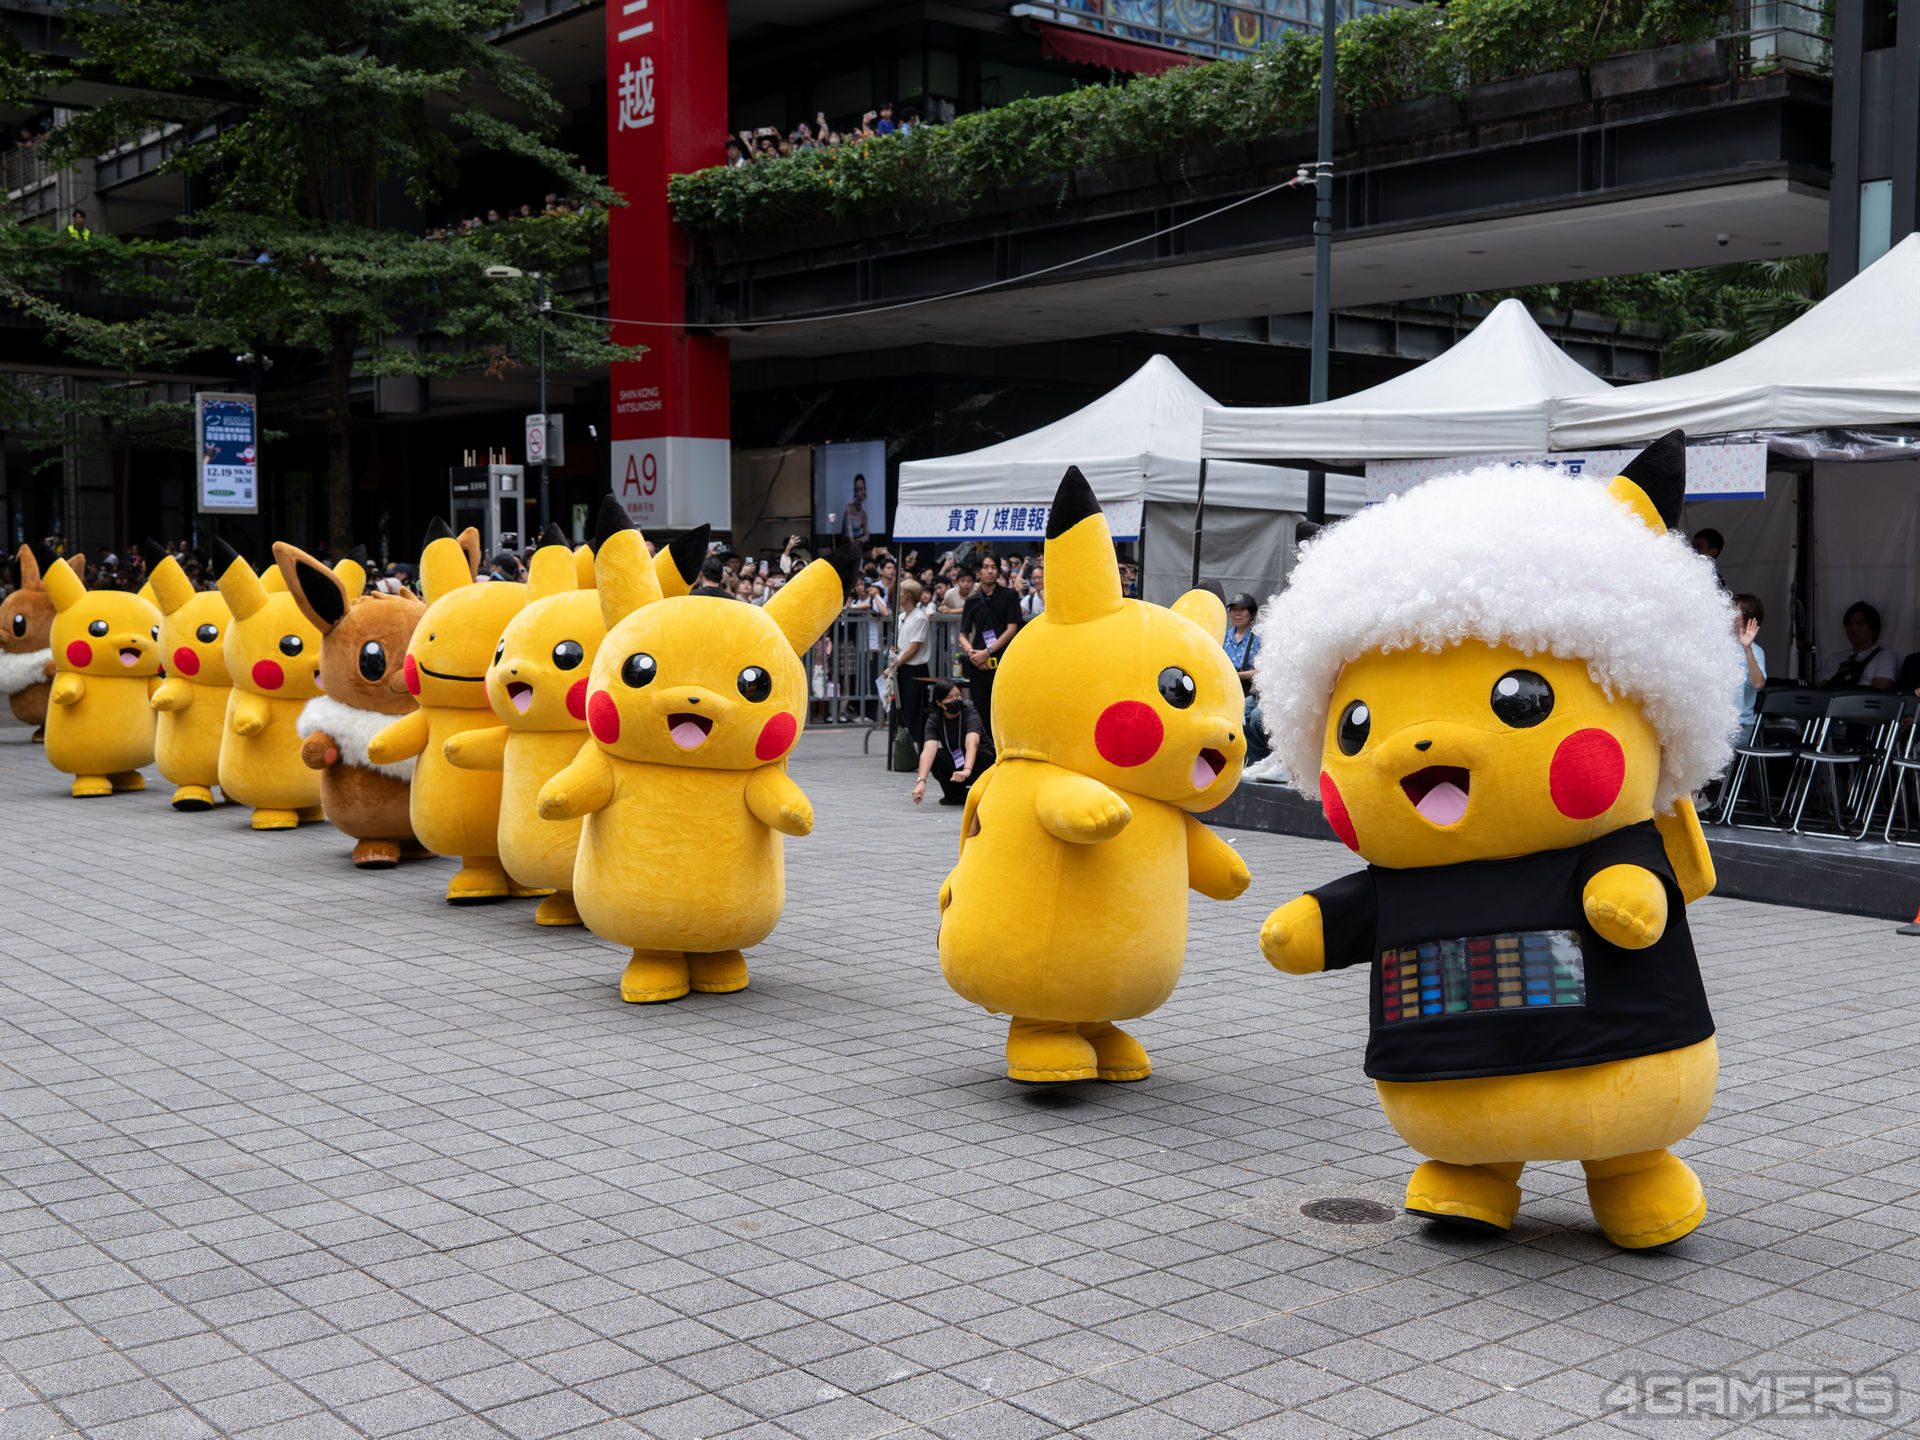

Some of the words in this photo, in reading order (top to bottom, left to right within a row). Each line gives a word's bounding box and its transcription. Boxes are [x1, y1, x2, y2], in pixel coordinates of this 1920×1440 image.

[619, 389, 637, 401] SHIN
[638, 386, 659, 398] KONG
[616, 400, 662, 414] MITSUKOSHI
[207, 468, 232, 477] 12.19
[622, 453, 657, 497] A9
[992, 507, 1052, 532] 媒體報
